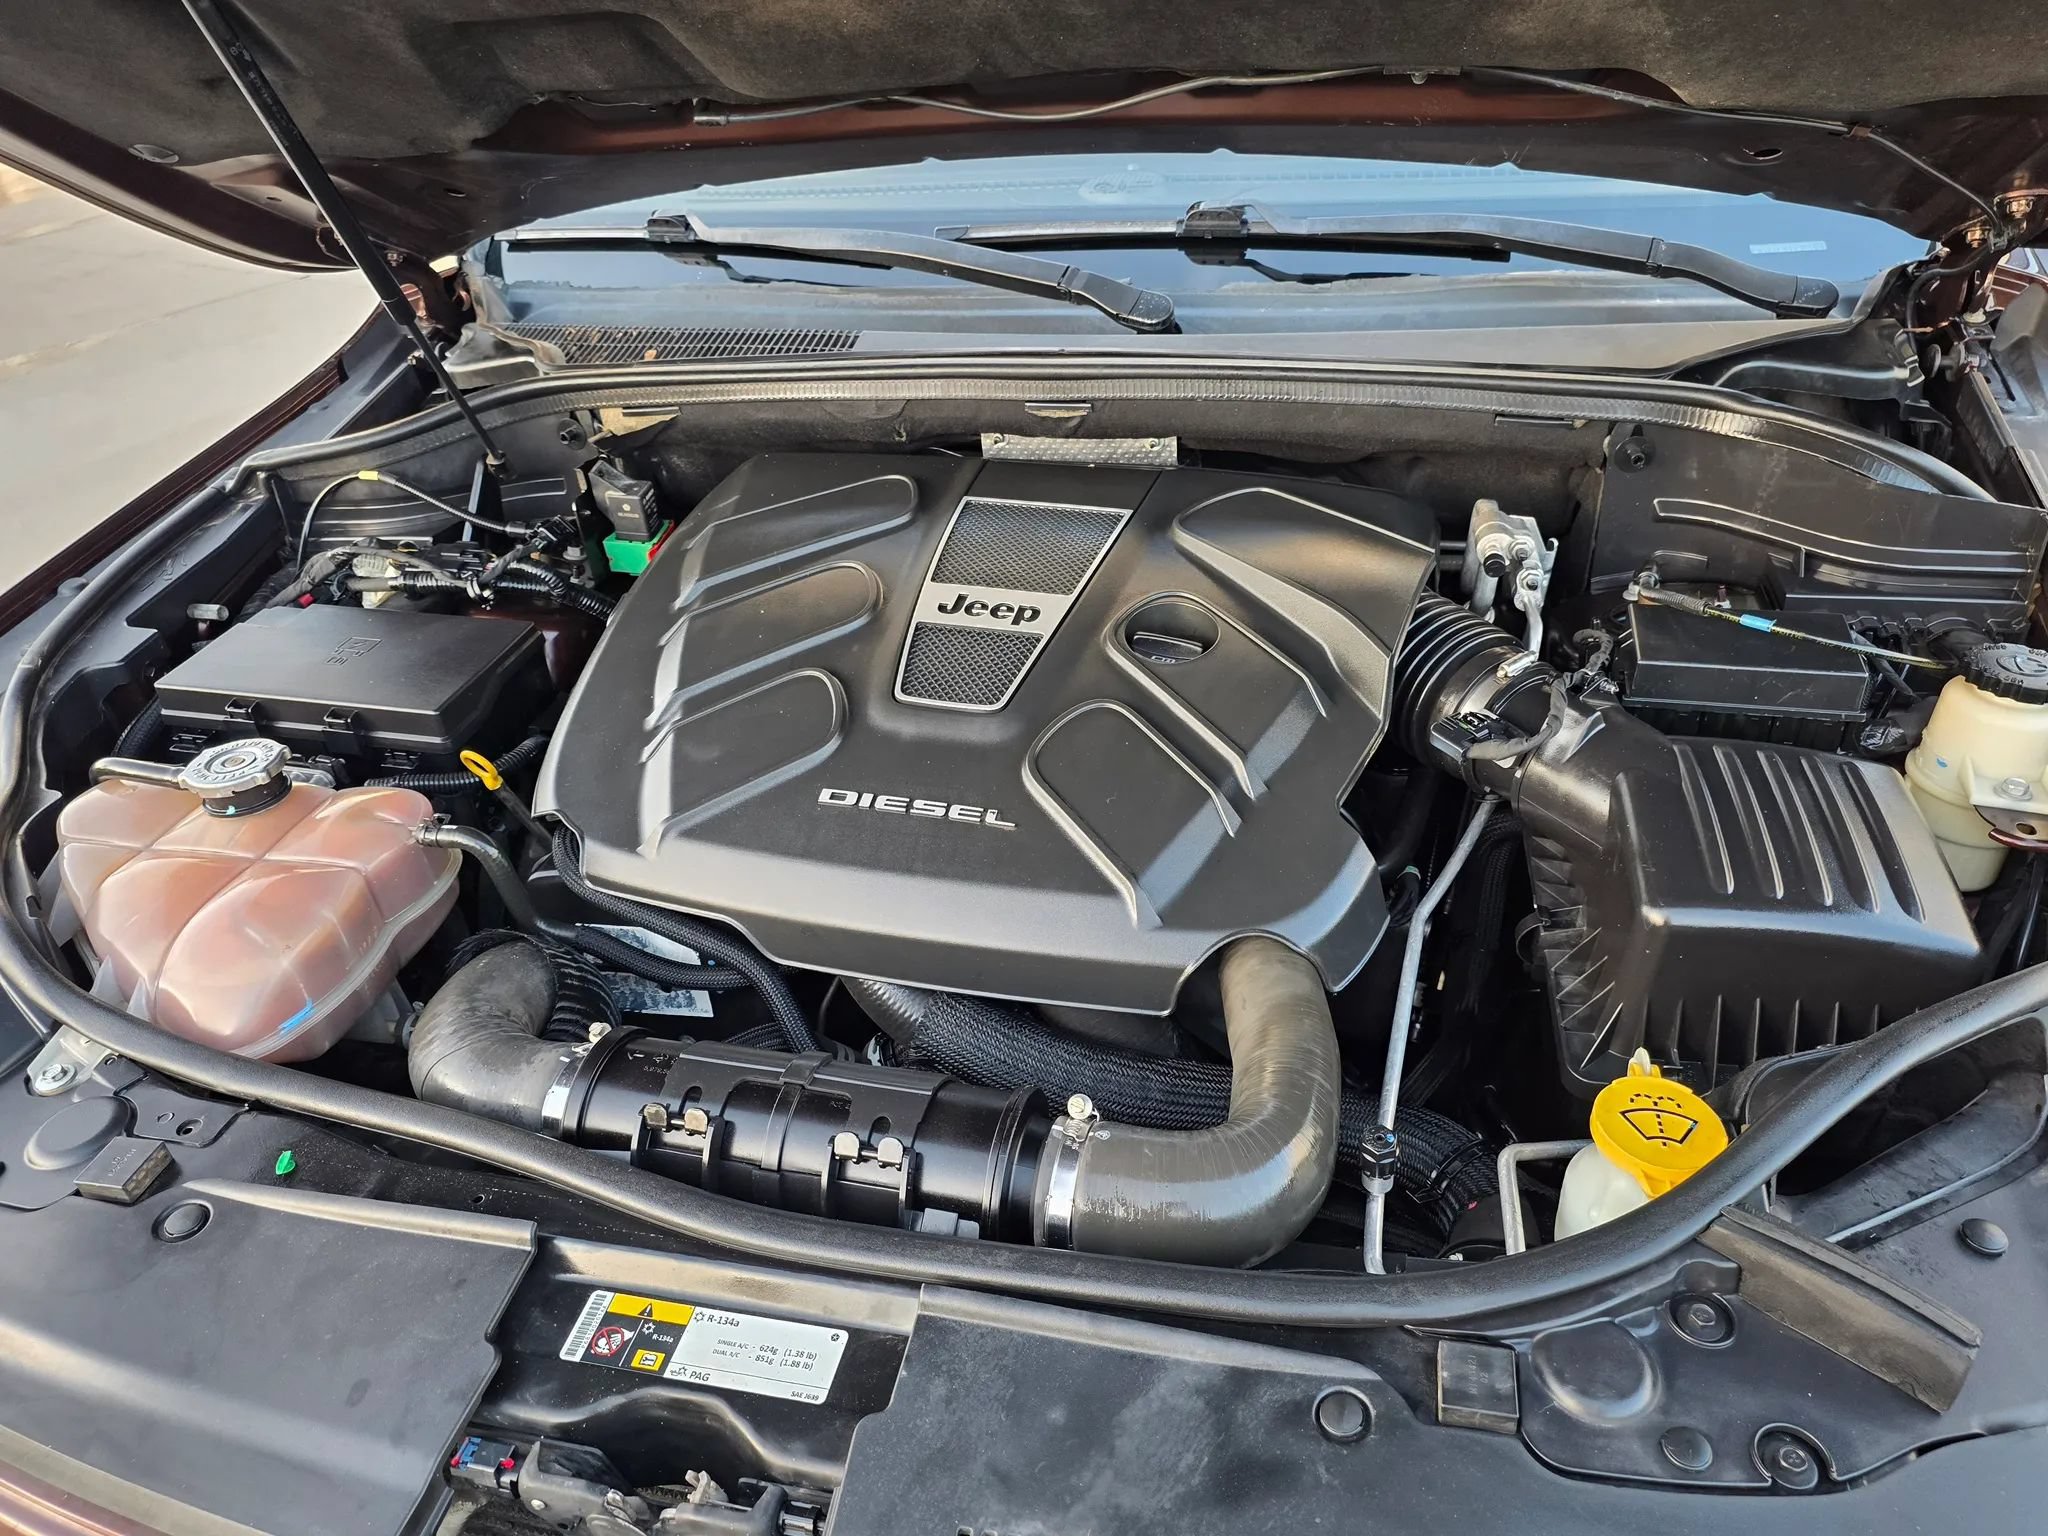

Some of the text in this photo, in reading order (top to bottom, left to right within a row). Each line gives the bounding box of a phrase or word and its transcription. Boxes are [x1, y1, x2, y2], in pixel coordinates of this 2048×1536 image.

[937, 593, 1042, 625] Jeep
[817, 787, 1017, 829] DIESEL
[706, 1315, 740, 1328] R-134a
[652, 1333, 674, 1343] R-134a
[717, 1339, 738, 1348] SINGLE
[737, 1342, 749, 1350] A/C
[759, 1344, 779, 1356] 624g
[783, 1347, 805, 1358] (1.38
[805, 1351, 818, 1362] lb)
[712, 1348, 728, 1357] DUAL
[728, 1351, 741, 1359] A/C
[755, 1354, 775, 1365] 851g
[779, 1357, 801, 1368] (1.88
[802, 1361, 814, 1372] lb)
[689, 1370, 711, 1382] PAG
[791, 1390, 804, 1399] SAE
